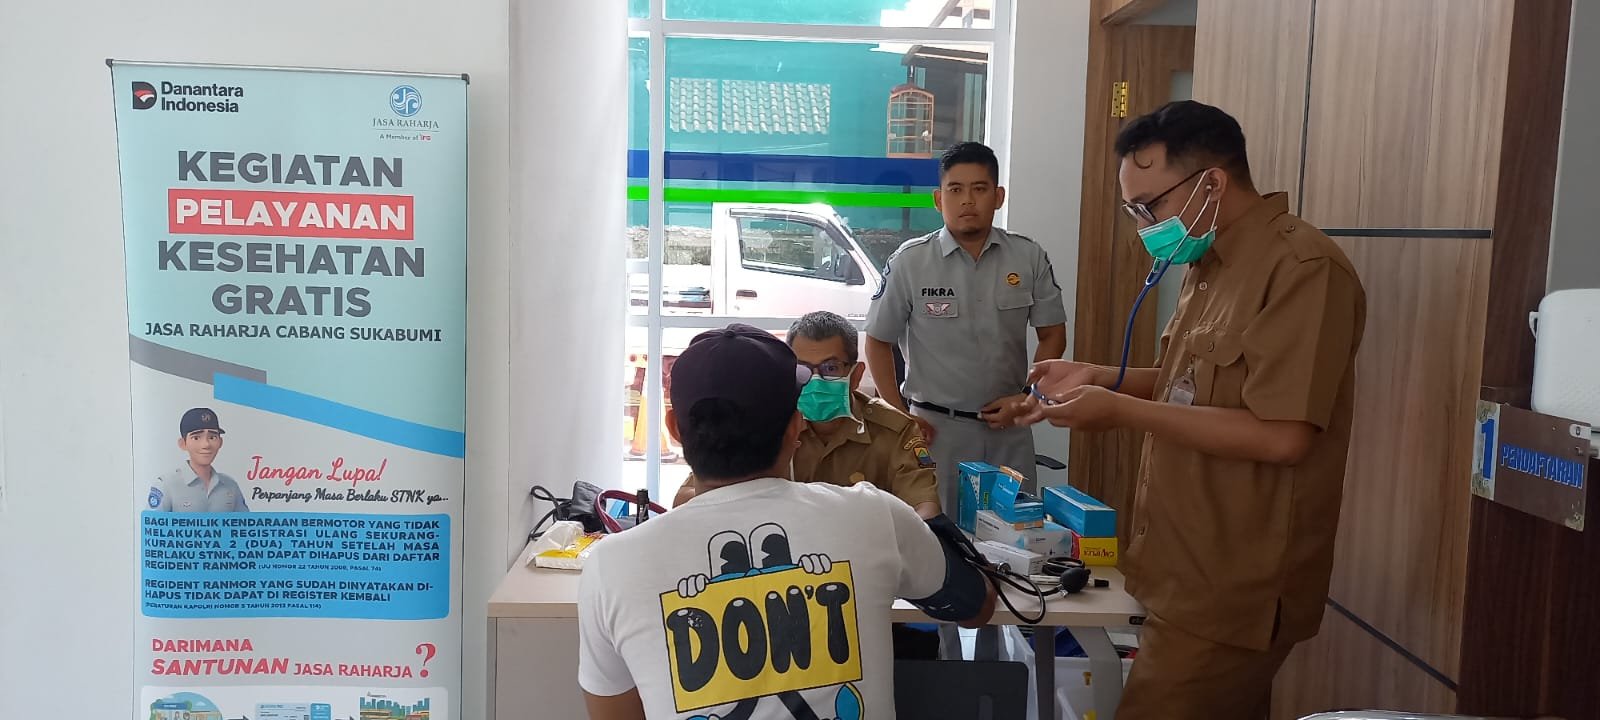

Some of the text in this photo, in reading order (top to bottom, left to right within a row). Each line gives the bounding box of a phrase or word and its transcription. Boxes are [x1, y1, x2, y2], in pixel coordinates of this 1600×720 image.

[161, 81, 244, 98] Danantara
[161, 97, 239, 113] Indonesia
[373, 117, 439, 129] JASA RAHARJA
[178, 150, 403, 187] KEGIATAN
[176, 198, 406, 230] PELAYANAN
[158, 241, 425, 278] KESEHATAN
[921, 288, 955, 297] FIKRA
[212, 284, 372, 318] GRATIS
[145, 322, 442, 342] JASA RAHARJA CABANG SUKABUMI
[1481, 418, 1494, 480] 1
[247, 456, 388, 486] Jangan Lupa!
[1501, 444, 1584, 489] PENDAFTARAN
[251, 487, 313, 502] Perpanjang
[315, 488, 344, 501] Masa
[346, 489, 388, 502] Berlaku
[390, 490, 426, 502] STNK
[144, 516, 440, 530] BAGI PEMILIK KENDARAAN BERMOTOR YANG TIDAK
[144, 527, 440, 541] MELAKUKAN REGISTRASI ULANG SEKURANG-
[144, 538, 440, 551] KURANGNYA 2 (DUA) TAHUN SETELAH MASA
[144, 550, 440, 562] BERLAKU STNK, DAN DAPAT DIHAPUS DARI DAFTAR
[144, 560, 200, 570] REGIDENT
[202, 561, 257, 570] RANMOR
[145, 578, 434, 591] REGIDENT RANMOR YANG SUDAH DINYATAKAN DI-
[145, 589, 391, 602] HAPUS TIDAK DAPAT DI REGISTER KEMBALI
[667, 582, 850, 692] DON'T
[152, 638, 253, 653] DARIMANA
[151, 643, 437, 678] SANTUNAN JASA RAHARJA ?
